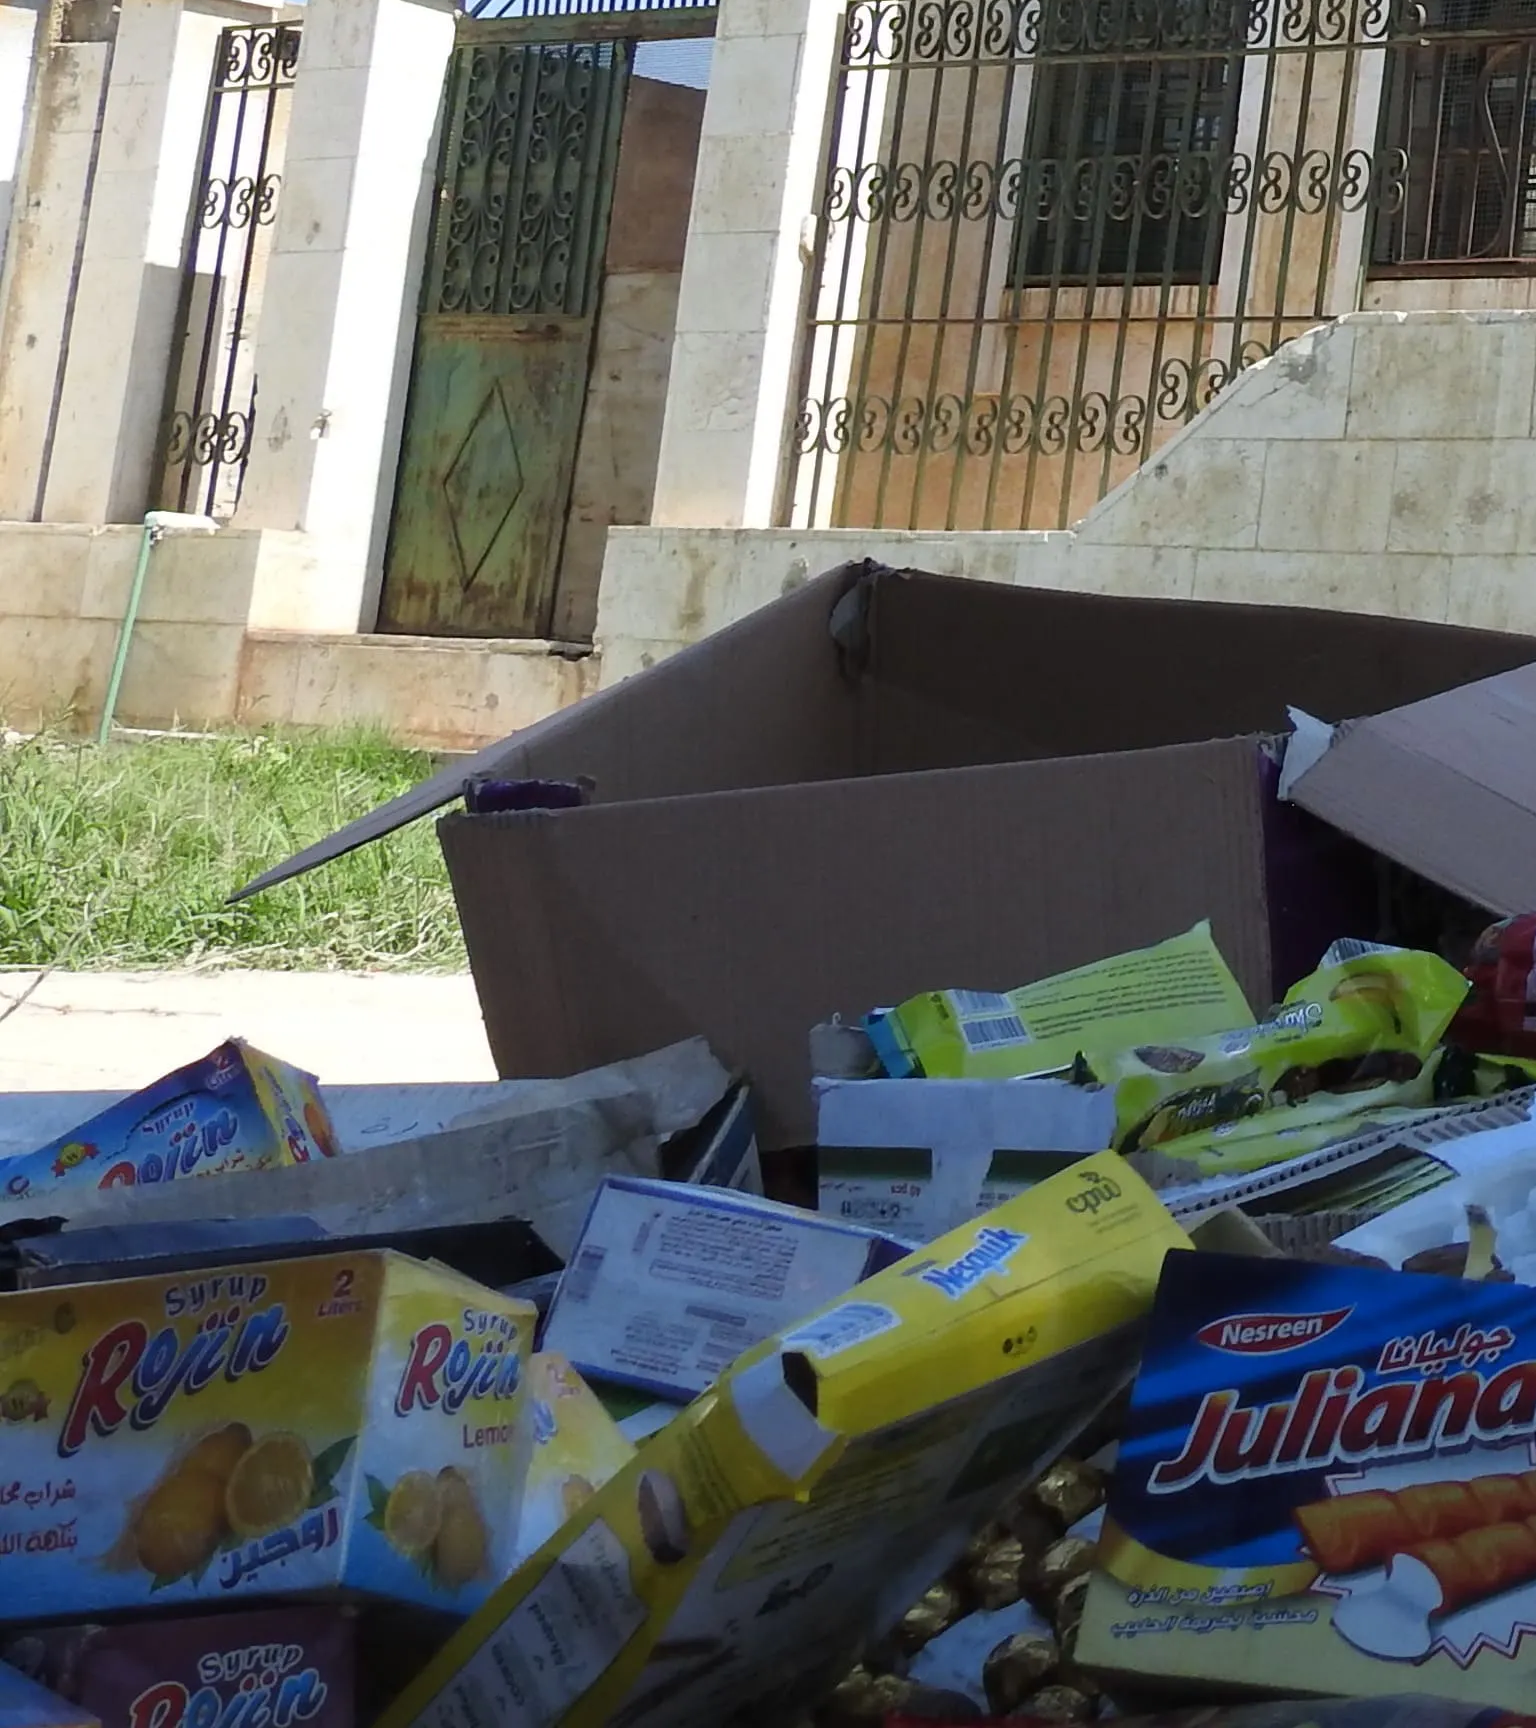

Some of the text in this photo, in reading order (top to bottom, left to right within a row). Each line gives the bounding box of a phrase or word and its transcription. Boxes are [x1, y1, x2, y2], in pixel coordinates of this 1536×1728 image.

[164, 1274, 268, 1317] Syrup
[334, 1269, 356, 1299] 2
[463, 1308, 519, 1343] Syrup
[1220, 1317, 1323, 1347] Nesreen
[1376, 1322, 1516, 1375] جوليانا
[198, 1643, 304, 1684] Syrup
